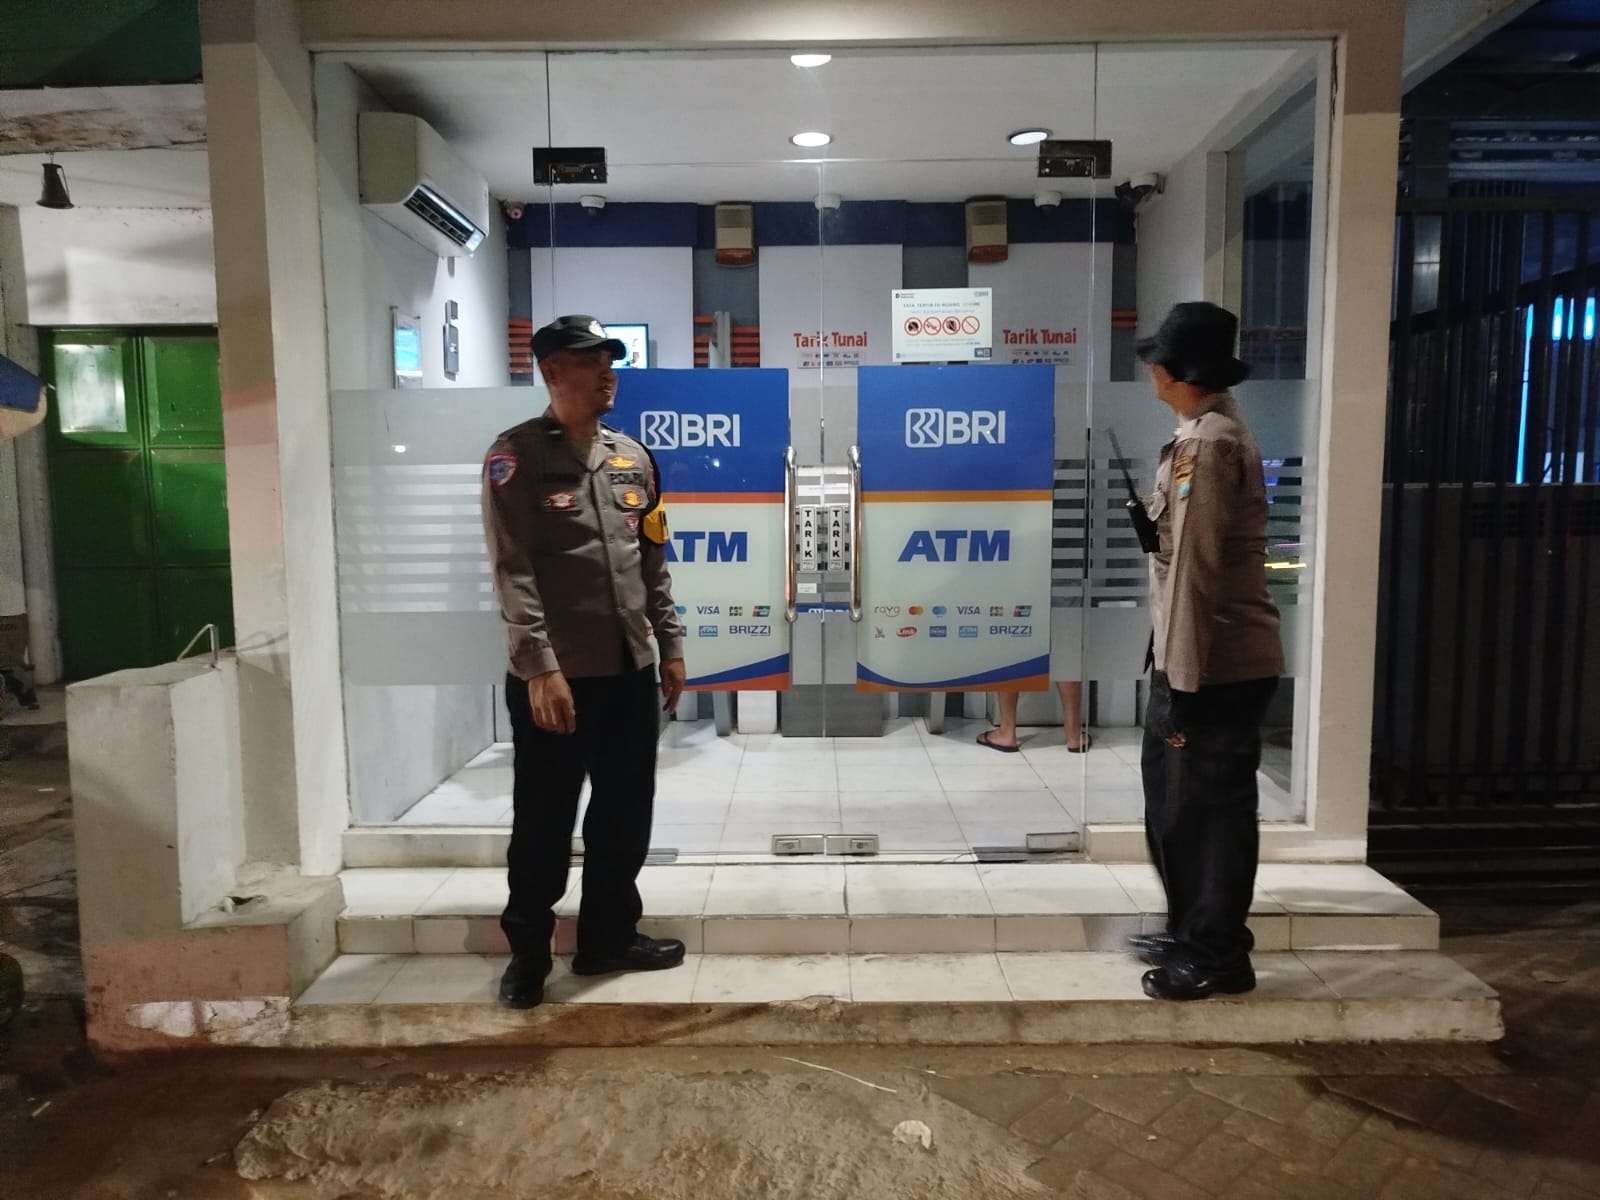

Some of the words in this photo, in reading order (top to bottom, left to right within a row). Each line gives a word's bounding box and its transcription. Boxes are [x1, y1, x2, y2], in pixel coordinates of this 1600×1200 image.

[793, 331, 829, 348] Tarik
[831, 331, 868, 348] Tunai
[1002, 329, 1038, 345] Tarik
[1040, 328, 1077, 345] Tunai
[681, 413, 741, 448] BRI
[946, 410, 1006, 445] BRI
[804, 510, 813, 558] TARIK
[832, 510, 841, 558] TARIK
[897, 529, 1010, 563] ATM
[697, 606, 720, 616] VISA
[956, 605, 981, 616] VISA
[729, 625, 771, 635] BRIZZI
[989, 625, 1032, 635] BRIZZI
